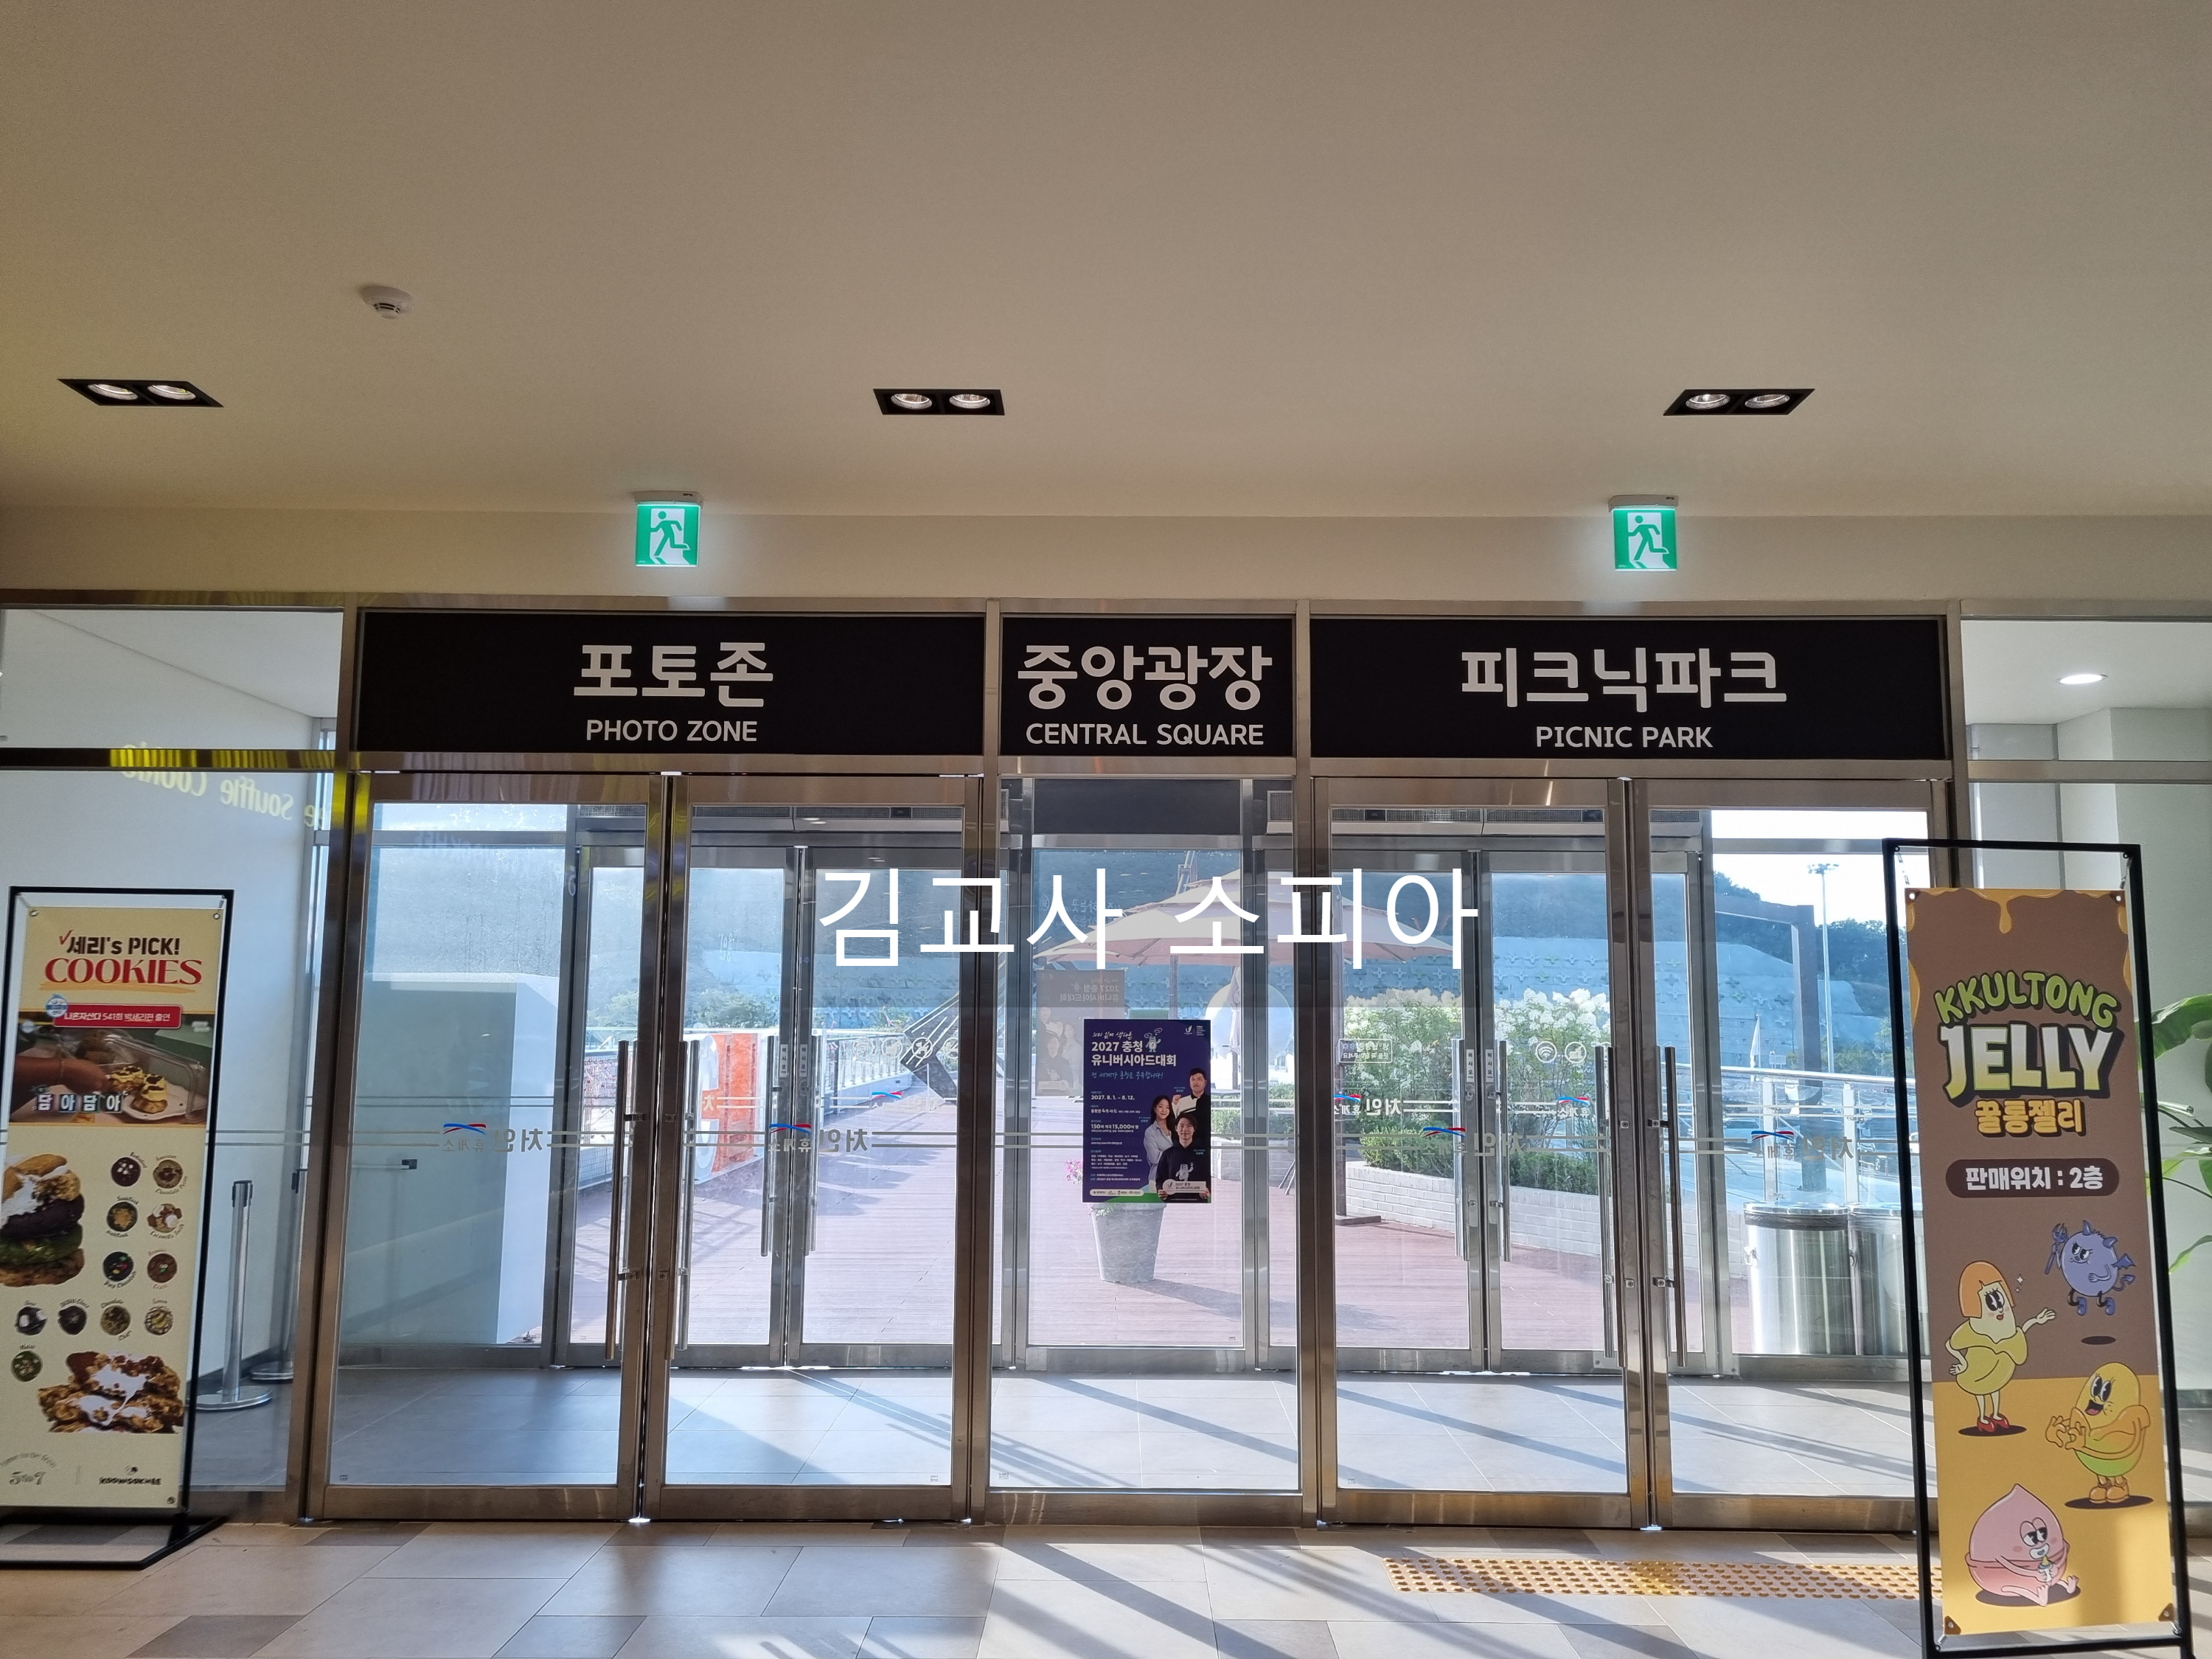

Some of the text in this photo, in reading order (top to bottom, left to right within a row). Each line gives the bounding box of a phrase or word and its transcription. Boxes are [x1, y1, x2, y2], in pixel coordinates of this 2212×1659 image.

[574, 642, 773, 707] 포토존
[1018, 645, 1273, 710] 중앙광장
[1461, 647, 1787, 713] 피크닉파크
[586, 720, 757, 742] PHOTO ZONE
[1026, 723, 1264, 745] CENTRAL SQUARE
[1537, 726, 1714, 748] PICNIC PARK
[128, 937, 181, 956] PICK!
[45, 958, 203, 985] COOKIES
[1933, 970, 2121, 1029] KKULTONG
[1091, 1040, 1143, 1052] 2027 충청
[1091, 1054, 1177, 1066] 유니버시아드대회
[1938, 1022, 2118, 1100] JELLY
[1975, 1099, 2086, 1137] 꿀통젤리
[1966, 1166, 2051, 1191] 판매위치
[2069, 1166, 2104, 1189] 2층
